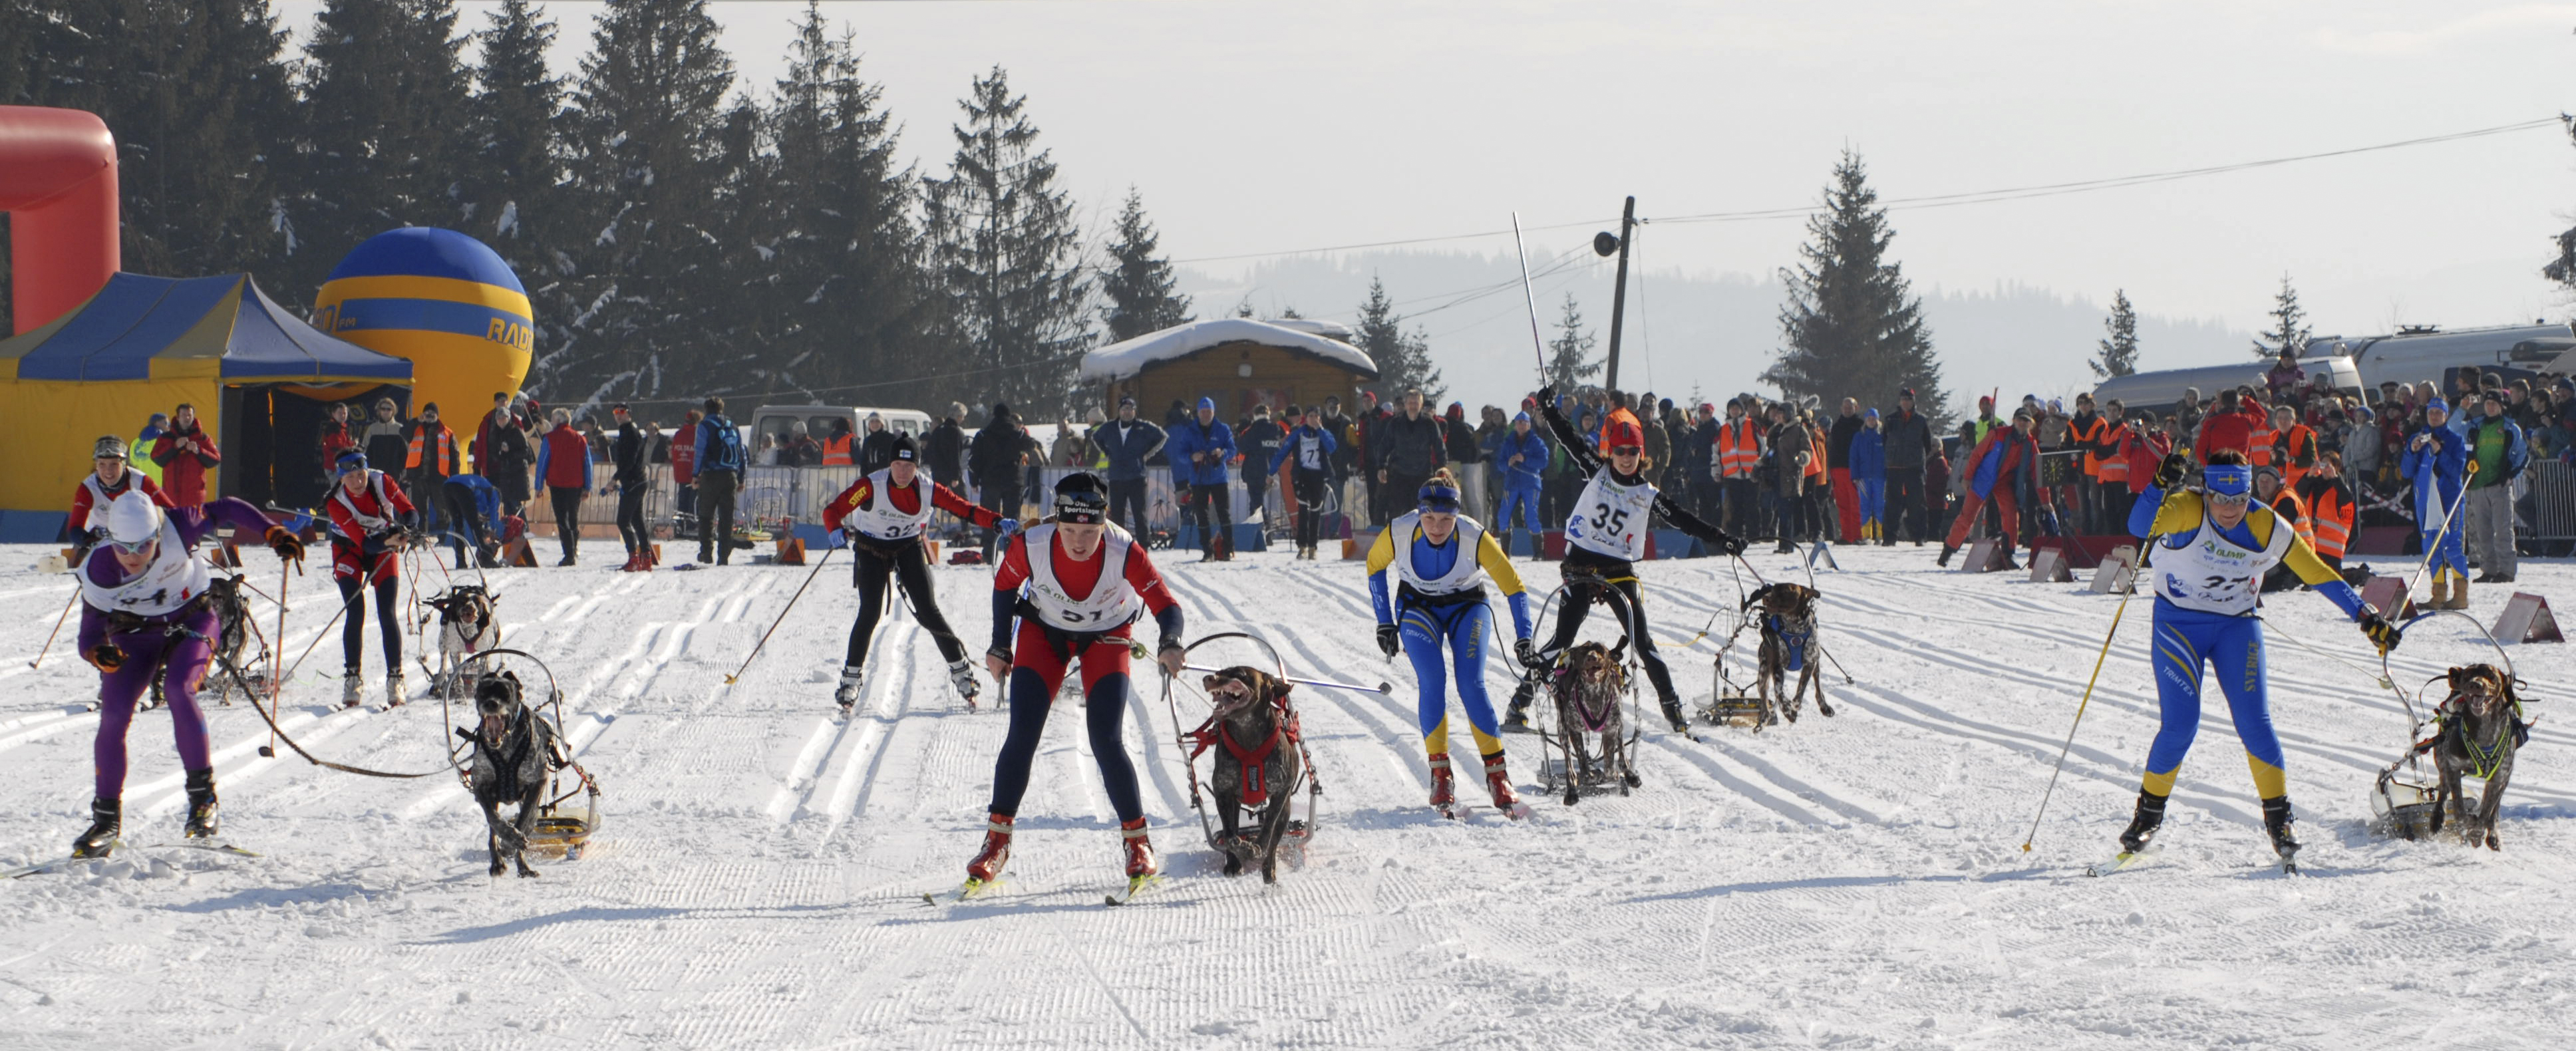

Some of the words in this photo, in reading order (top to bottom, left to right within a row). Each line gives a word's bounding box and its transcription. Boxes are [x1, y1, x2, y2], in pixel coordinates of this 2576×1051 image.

[1591, 503, 1629, 537] 35
[2216, 548, 2247, 560] OLIMP
[1405, 629, 1432, 644] TRIMTEX
[2163, 665, 2195, 697] TRIMTEX
[2244, 640, 2259, 692] SVERIGE
